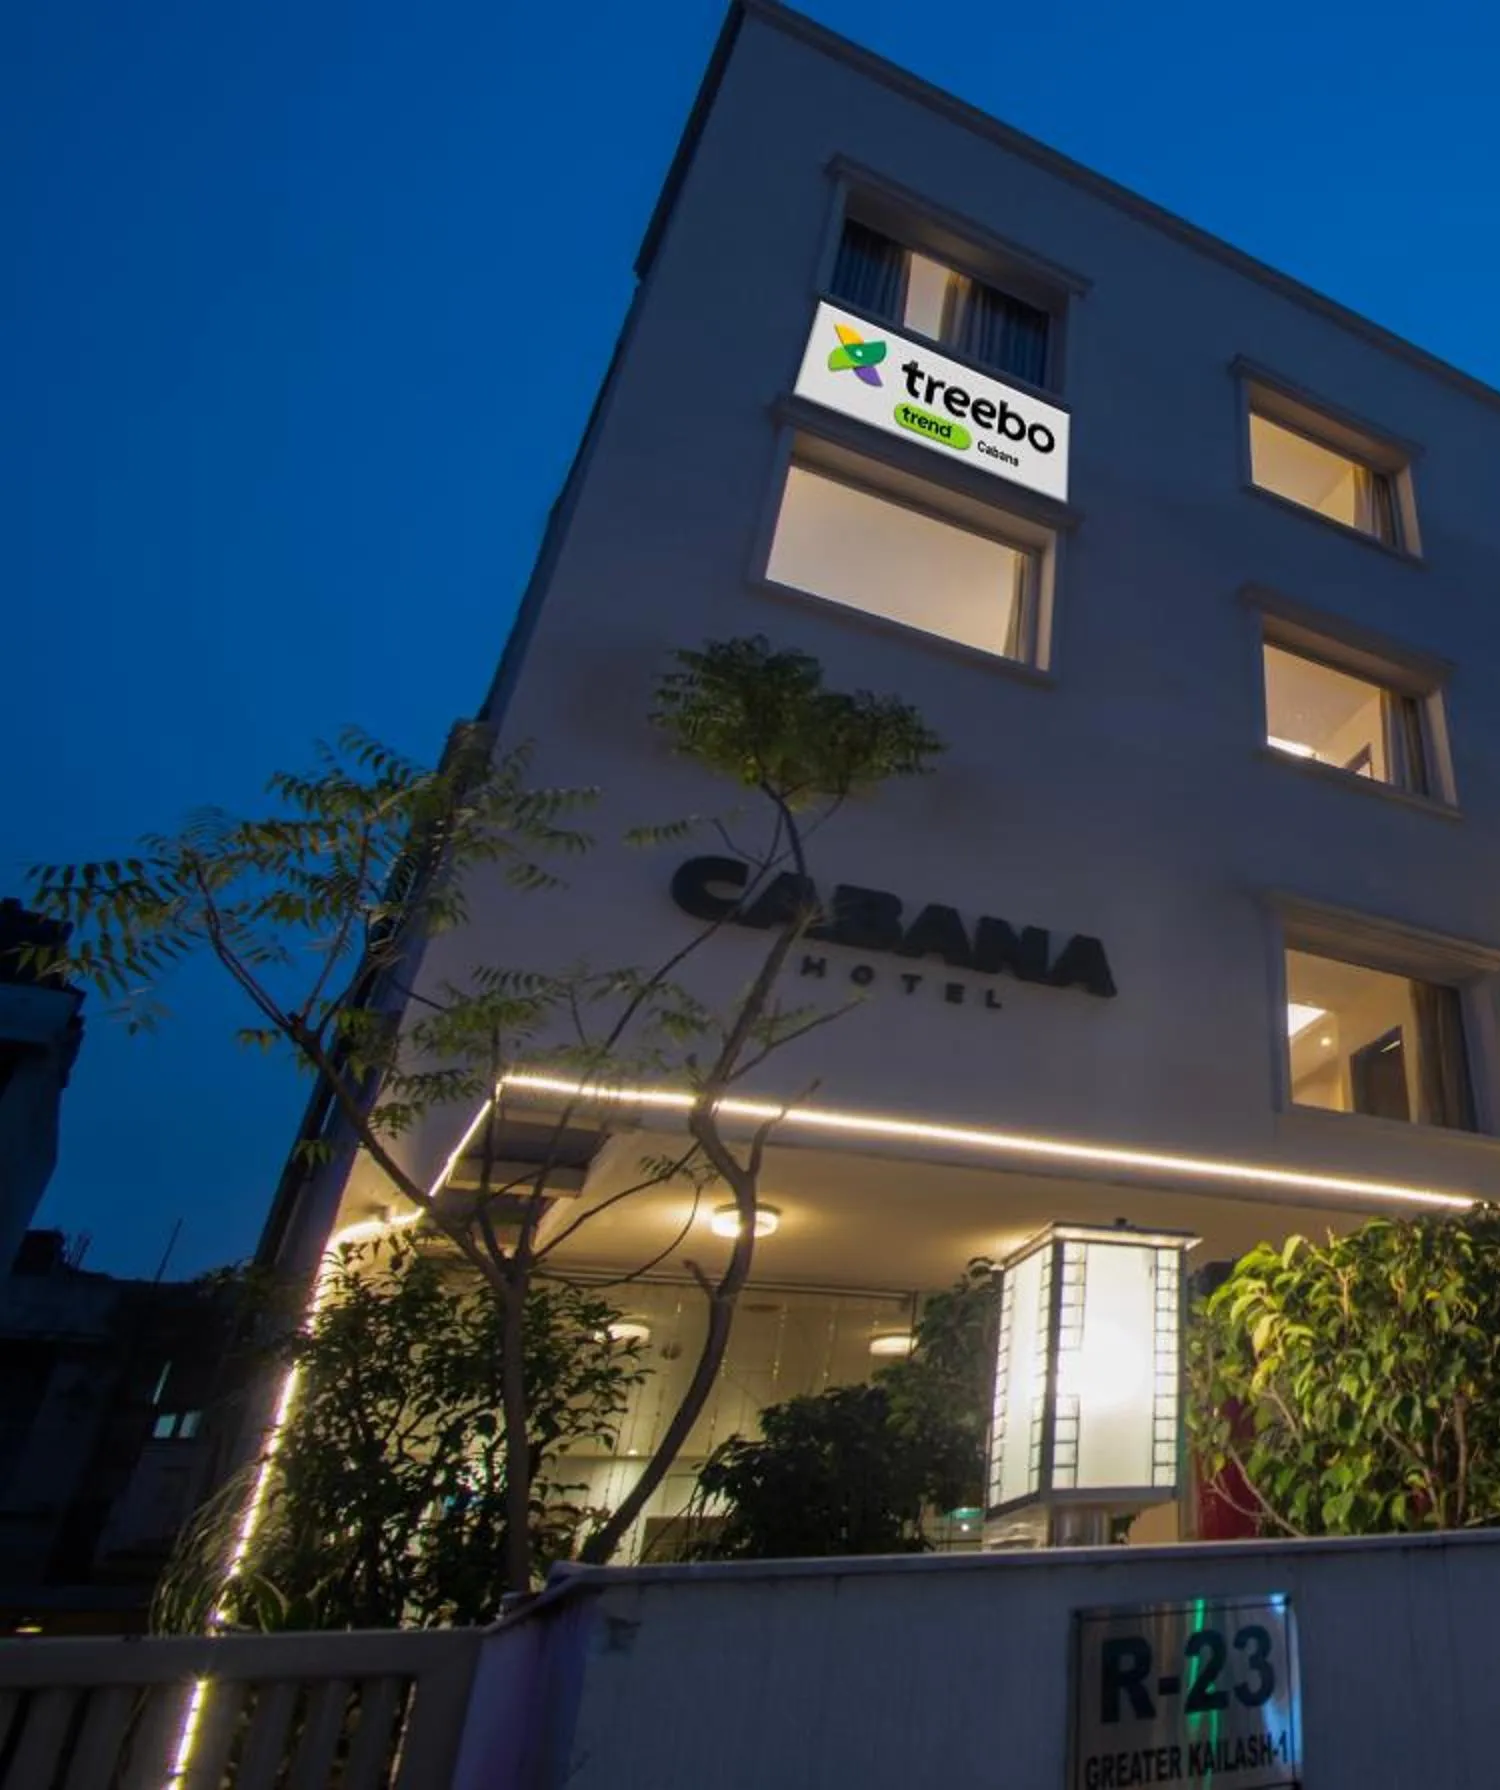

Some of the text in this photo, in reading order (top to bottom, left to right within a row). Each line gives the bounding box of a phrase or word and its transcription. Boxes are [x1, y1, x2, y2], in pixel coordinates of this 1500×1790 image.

[901, 360, 1055, 453] treebo
[902, 407, 953, 438] trend
[977, 439, 1019, 466] Cabana
[670, 855, 1117, 998] CABANA
[800, 955, 1001, 1010] HOTEL
[1101, 1625, 1275, 1724] R-23
[1085, 1730, 1288, 1790] GREATER KAILASH-1
